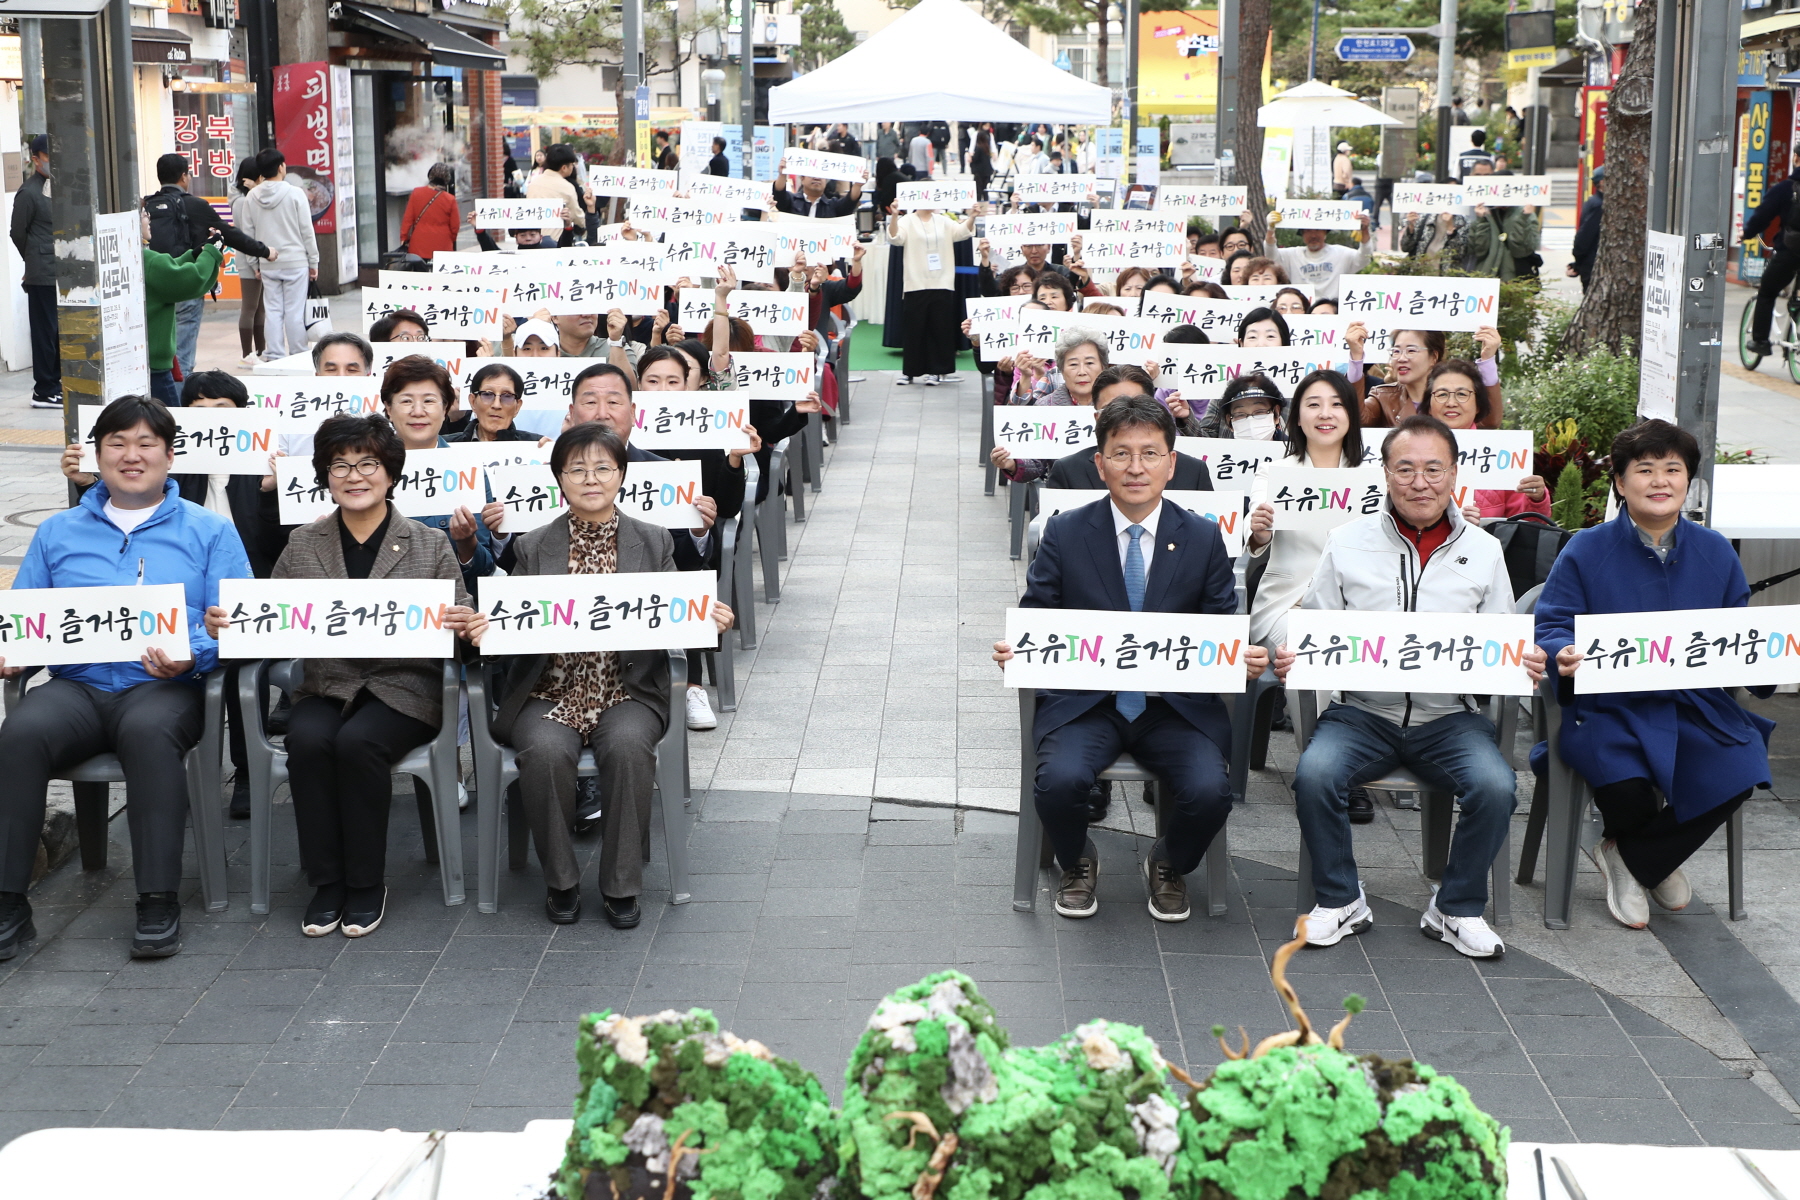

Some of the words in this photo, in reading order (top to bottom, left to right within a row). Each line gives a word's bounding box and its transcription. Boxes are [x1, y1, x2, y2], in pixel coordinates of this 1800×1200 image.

[174, 114, 235, 143] 강북
[301, 70, 331, 176] 피냉면
[786, 154, 818, 170] 수유IN,
[820, 158, 864, 176] 즐거움ON
[592, 174, 627, 188] 수유IN,
[628, 175, 675, 191] 즐거움ON
[1018, 182, 1049, 194] 수유IN,
[1051, 181, 1093, 195] 즐거움ON
[1466, 183, 1500, 197] 수유IN,
[1502, 183, 1548, 197] 즐거움ON
[900, 189, 931, 202] 수유IN,
[933, 188, 974, 202] 즐거움ON
[1163, 194, 1196, 207] 수유IN,
[1199, 193, 1244, 208] 즐거움ON
[480, 206, 512, 220] 수유IN,
[632, 204, 668, 221] 수유IN,
[671, 206, 722, 225] 즐거움ON
[989, 222, 1023, 237] 수유IN,
[1027, 221, 1074, 236] 즐거움ON
[1094, 218, 1131, 232] 수유IN,
[666, 241, 717, 263] 수유IN,
[1086, 242, 1126, 257] 수유IN,
[1129, 241, 1183, 258] 즐거움ON
[513, 281, 564, 301] 수유IN,
[568, 277, 638, 302] 즐거움ON
[1343, 290, 1403, 313] 수유IN,
[1409, 290, 1494, 316] 즐거움ON
[423, 304, 499, 326] 즐거움ON
[1146, 304, 1196, 326] 수유IN,
[654, 406, 744, 434] 즐거움ON
[999, 421, 1058, 444] 수유IN,
[1273, 485, 1352, 514] 수유IN,
[228, 600, 317, 635] 수유IN,
[325, 599, 446, 637] 즐거움ON
[488, 598, 580, 631] 수유IN,
[588, 594, 710, 630] 즐거움ON
[60, 606, 179, 645] 즐거움ON
[1013, 632, 1106, 668] 수유IN,
[1115, 633, 1242, 671] 즐거움ON
[1297, 633, 1389, 668] 수유IN,
[1398, 633, 1526, 672] 즐거움ON
[1583, 635, 1675, 669] 수유IN,
